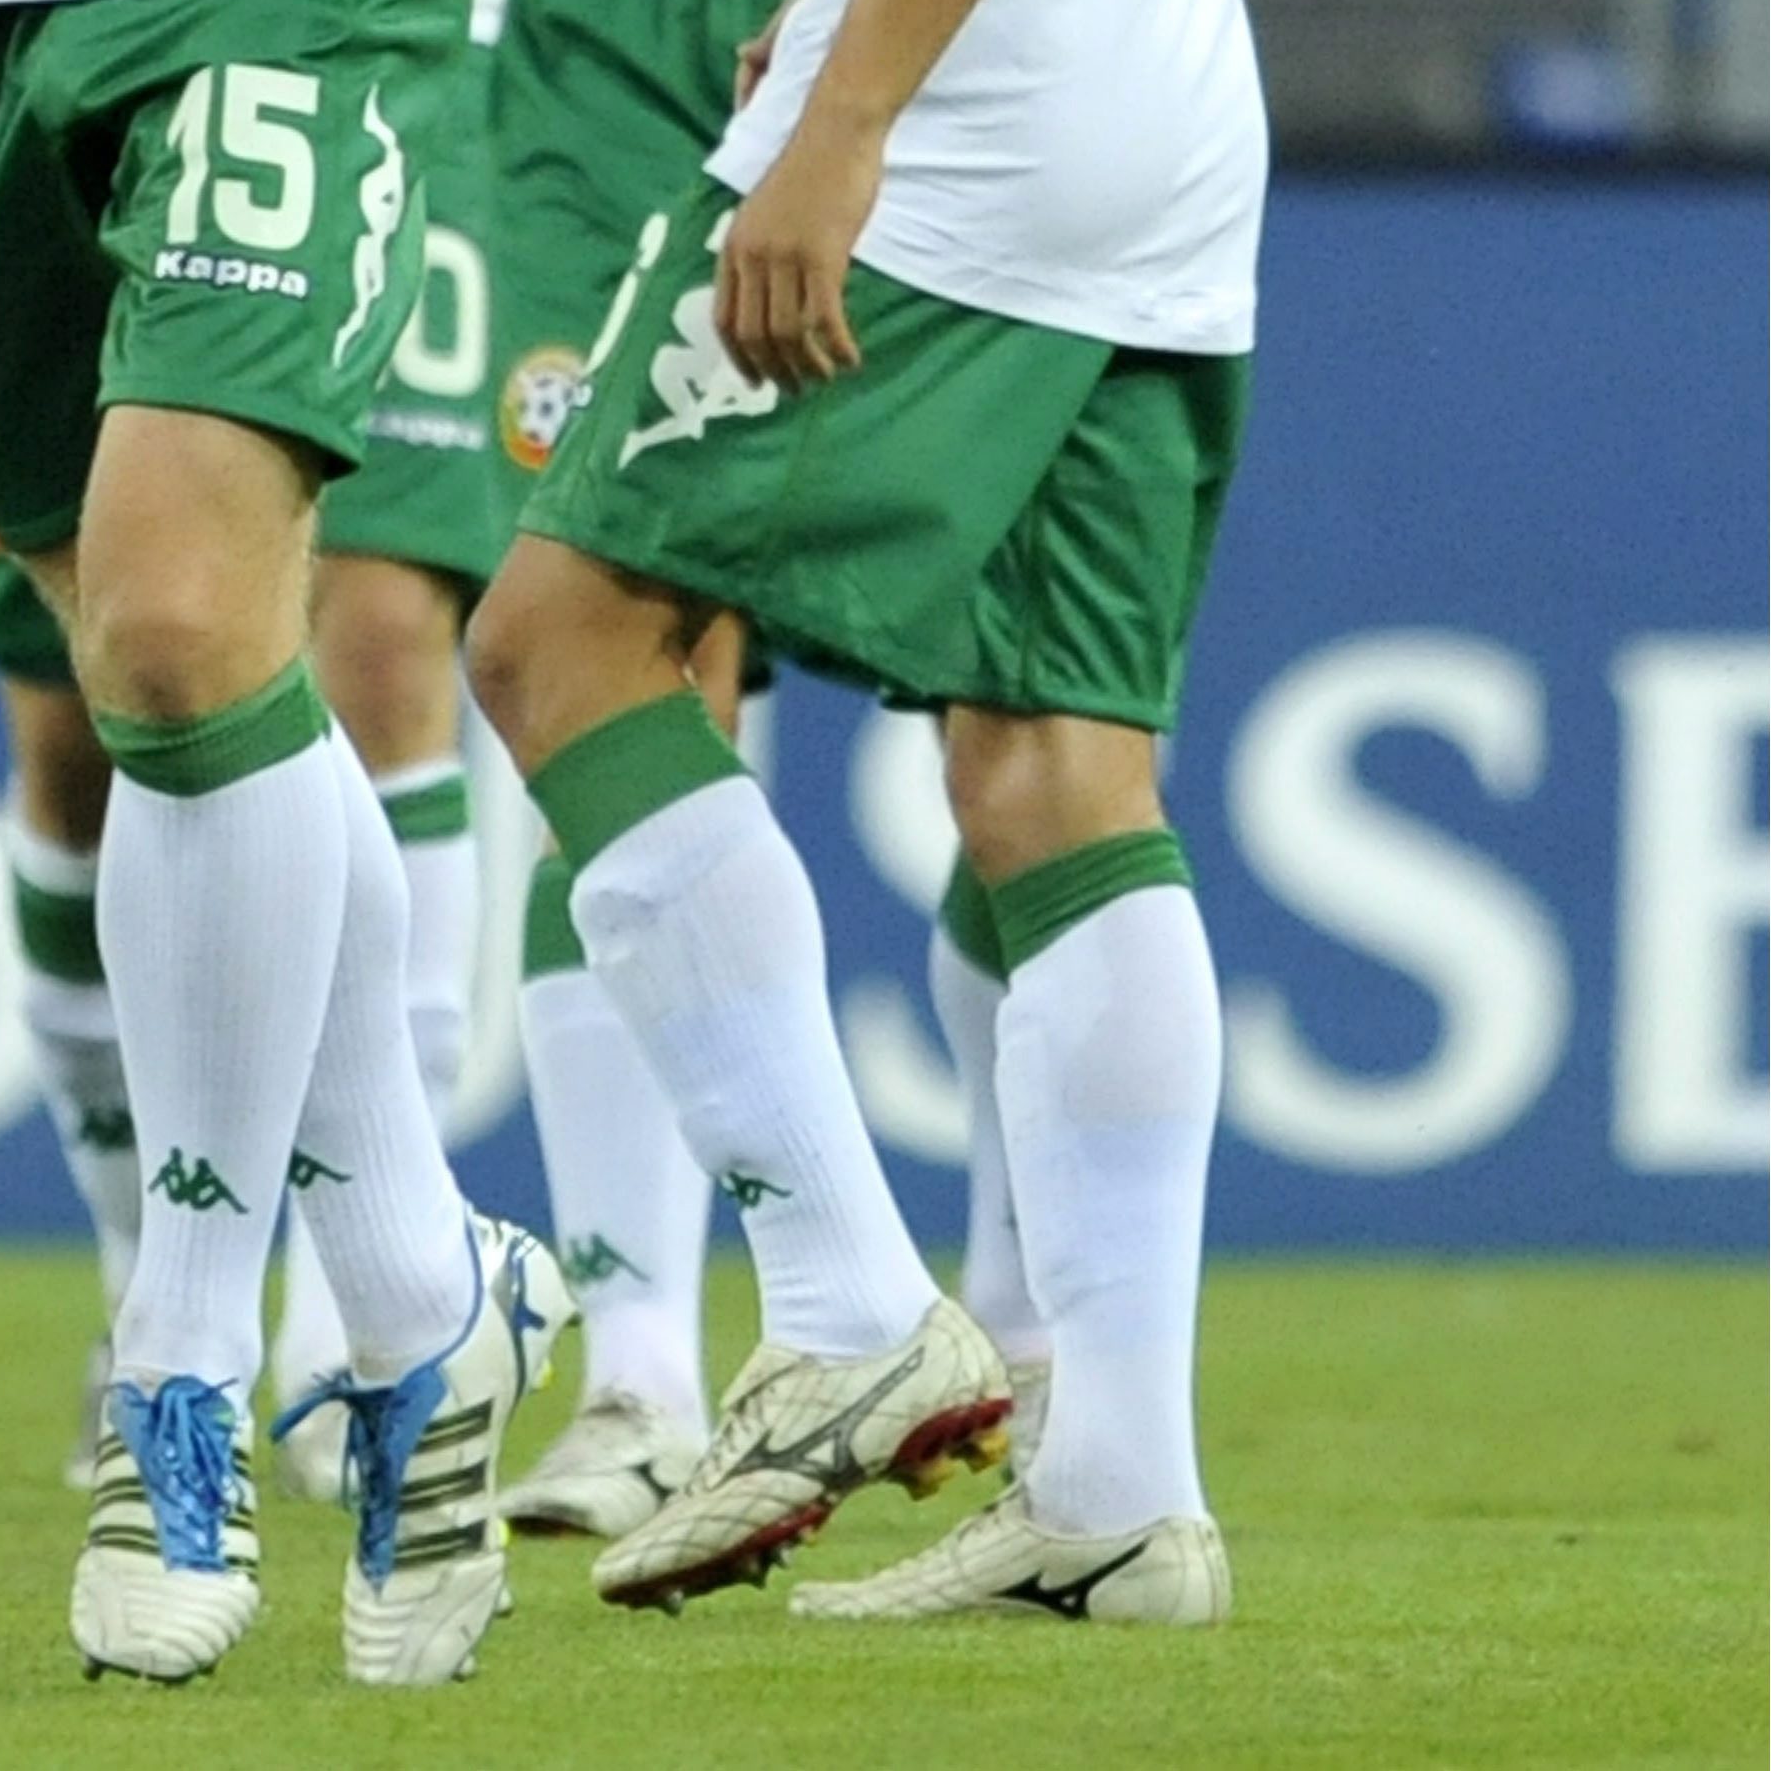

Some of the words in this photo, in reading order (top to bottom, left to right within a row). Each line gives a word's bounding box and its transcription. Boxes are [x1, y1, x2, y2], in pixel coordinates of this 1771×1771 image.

[165, 63, 320, 251] 15
[155, 250, 308, 299] Kappa
[375, 224, 489, 398] 0
